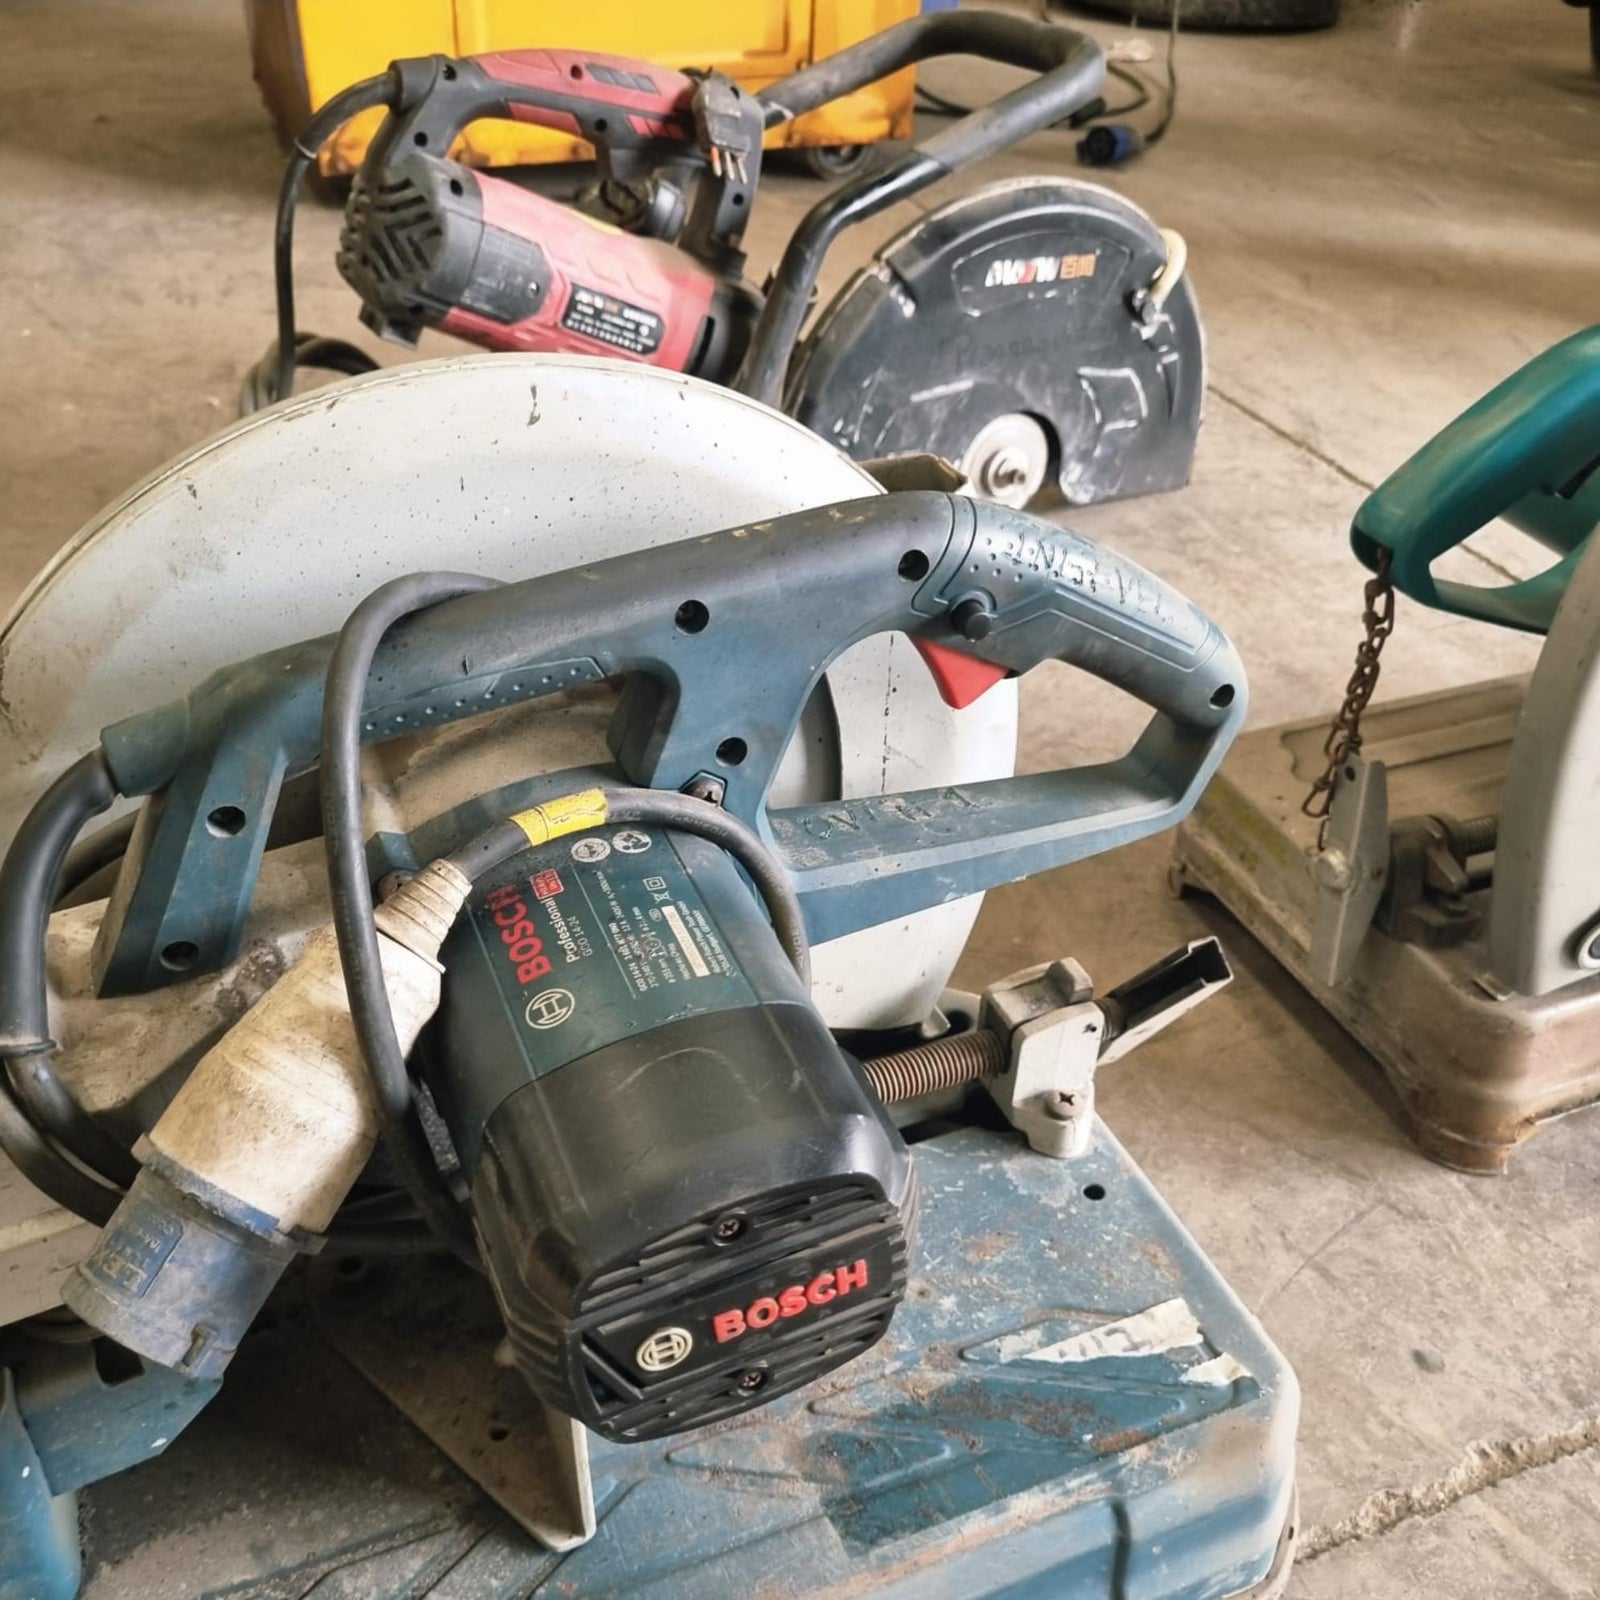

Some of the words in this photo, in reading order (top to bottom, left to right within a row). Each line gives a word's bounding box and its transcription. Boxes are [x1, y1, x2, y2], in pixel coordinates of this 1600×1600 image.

[486, 882, 552, 984] BOSCH
[540, 896, 580, 962] Professional
[567, 914, 585, 936] 14-24
[575, 936, 593, 957] GCO
[712, 1258, 869, 1344] BOSCH
